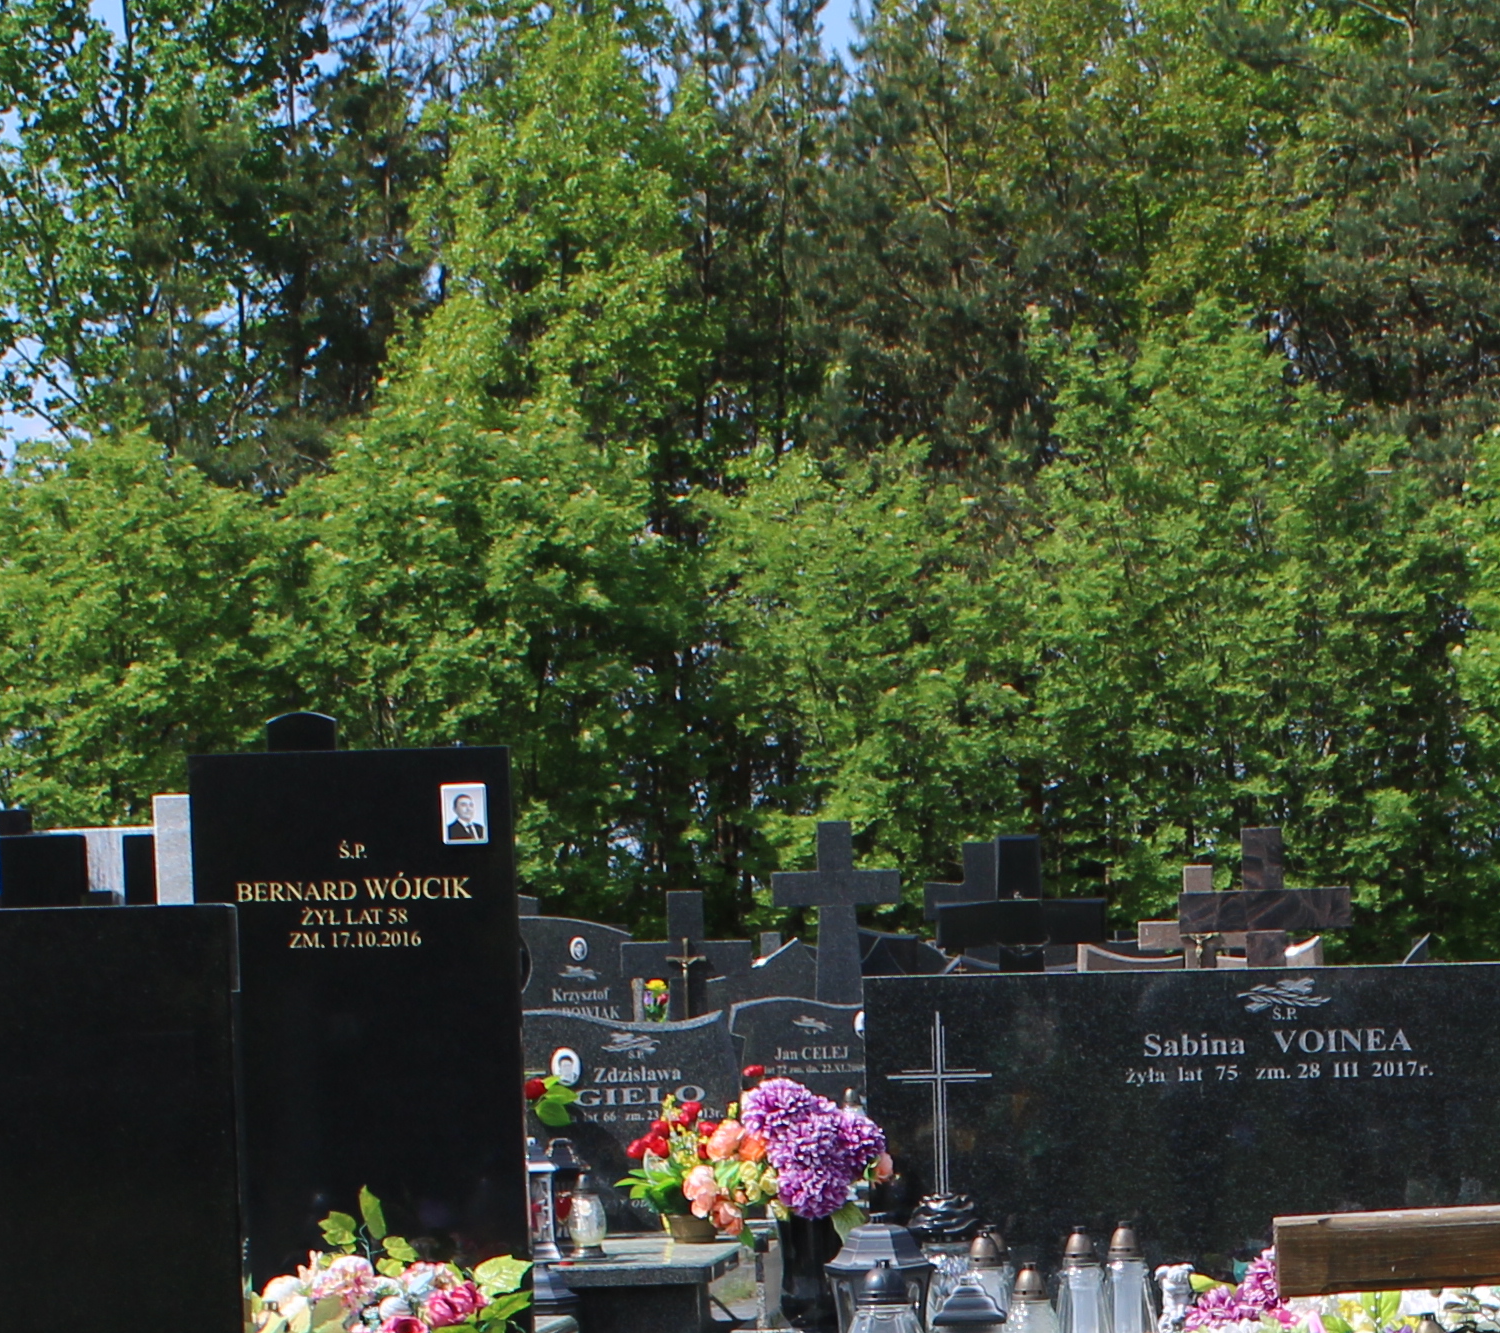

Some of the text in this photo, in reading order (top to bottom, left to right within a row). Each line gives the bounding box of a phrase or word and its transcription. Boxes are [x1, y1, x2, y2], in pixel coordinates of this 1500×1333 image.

[236, 871, 473, 903] BERNARD WÓJCIK
[301, 906, 409, 926] ŻYŁ LAT 58
[289, 930, 422, 949] ZM. 17.10.2016
[552, 987, 610, 1004] Krzysztof
[1143, 1028, 1413, 1058] Sabina VOINEA
[774, 1046, 849, 1060] Jan CELEJ
[594, 1066, 682, 1084] Zdzisława
[1125, 1060, 1435, 1087] żyła lat 75 zm. 28 III 2017r.
[603, 1111, 617, 1122] 66
[625, 1112, 645, 1121] zm.
